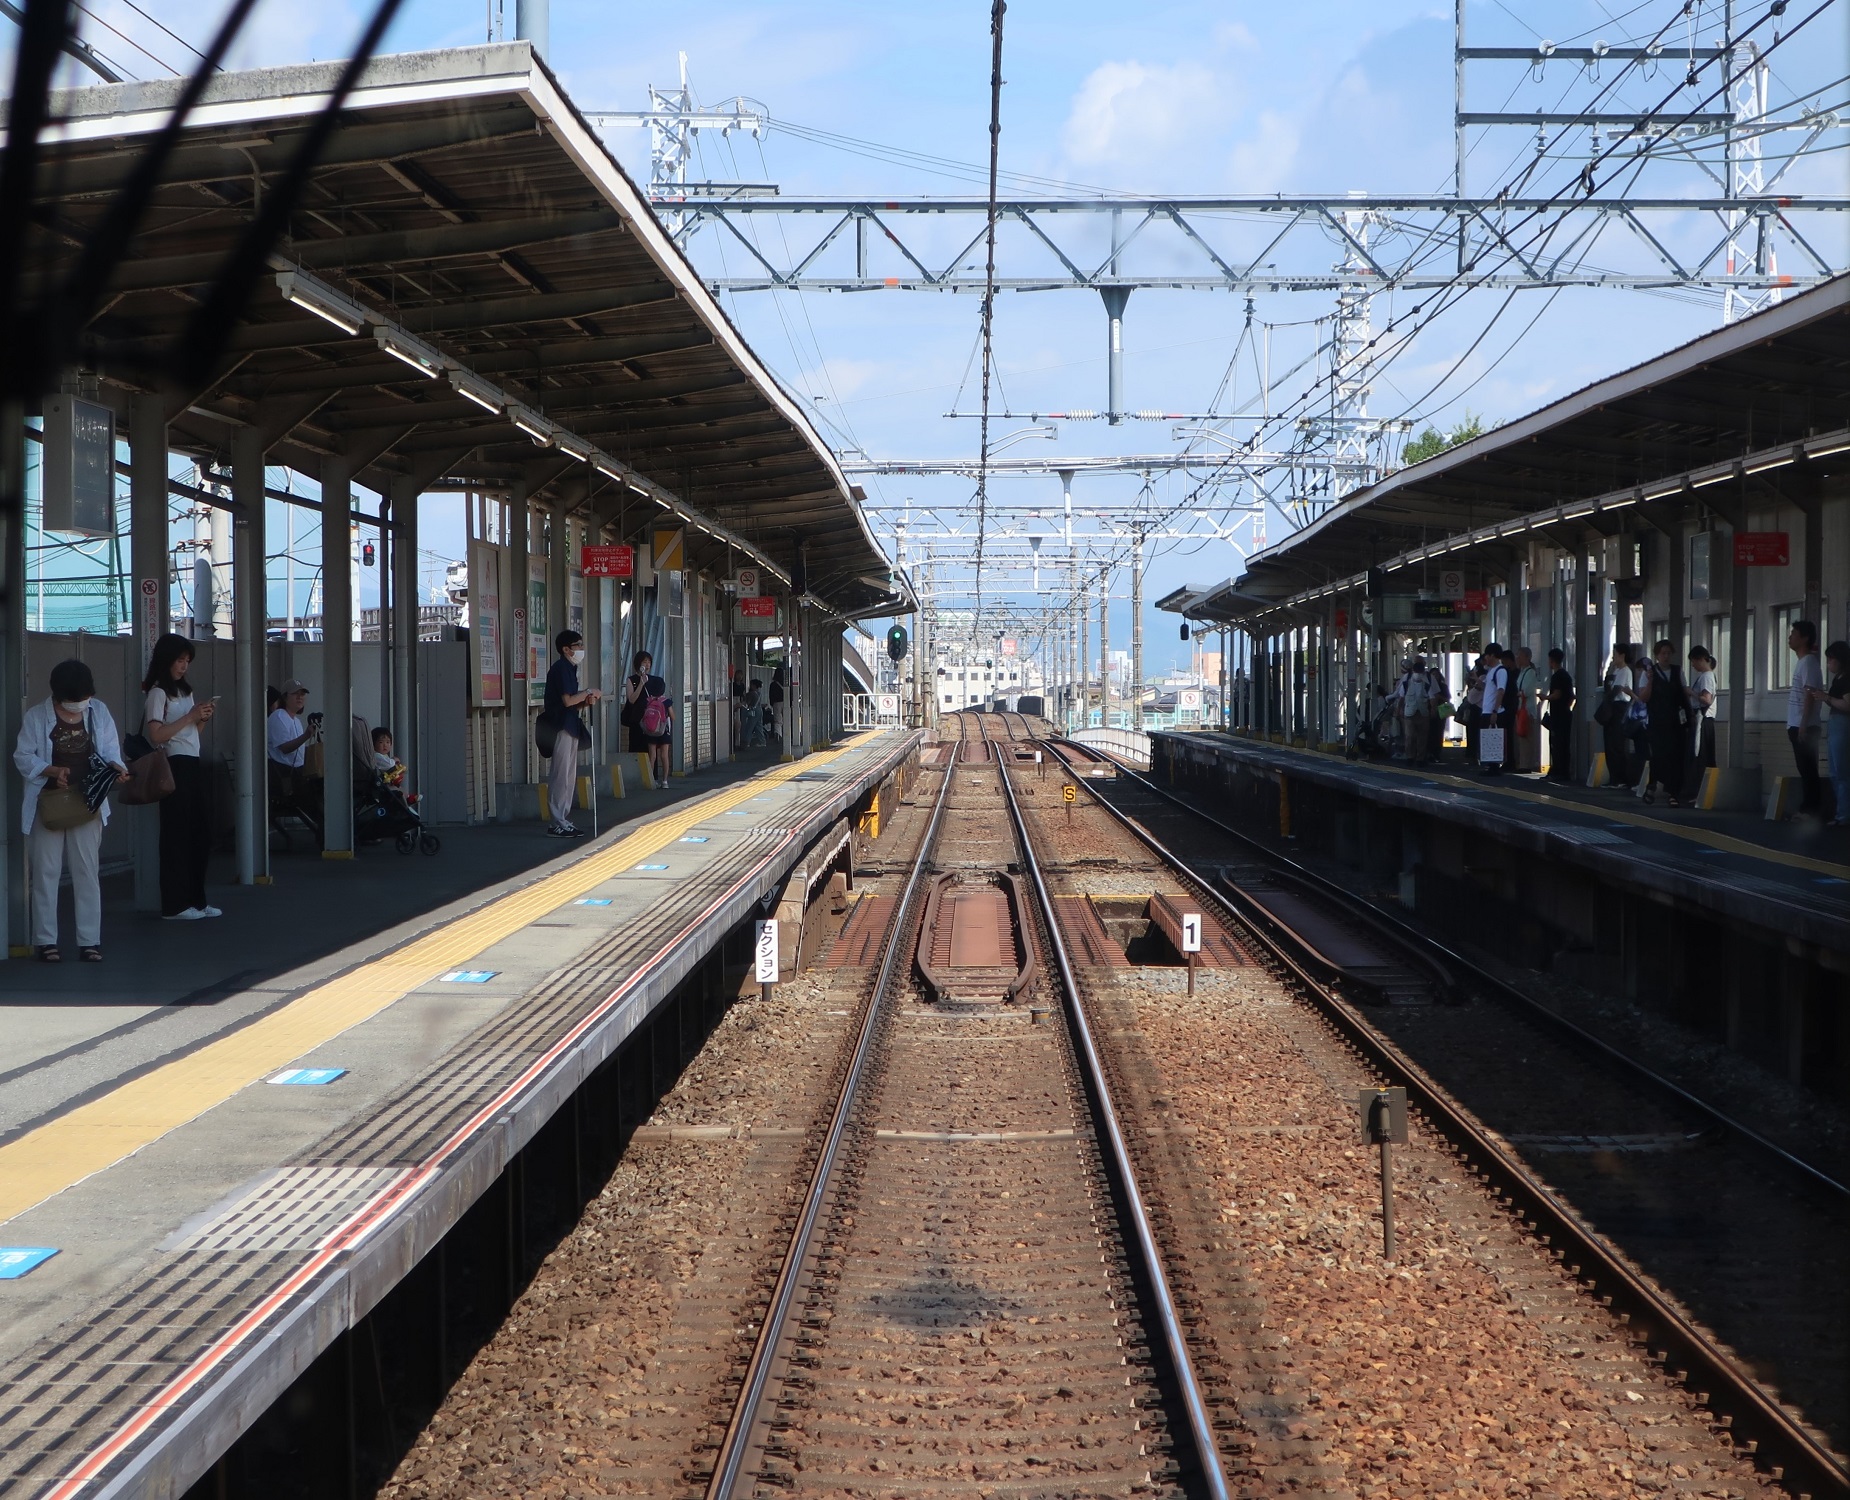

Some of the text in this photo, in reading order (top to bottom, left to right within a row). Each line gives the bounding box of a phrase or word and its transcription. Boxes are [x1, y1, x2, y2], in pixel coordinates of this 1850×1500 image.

[1065, 788, 1075, 800] S
[1185, 922, 1195, 944] 1
[760, 923, 773, 979] セクション
